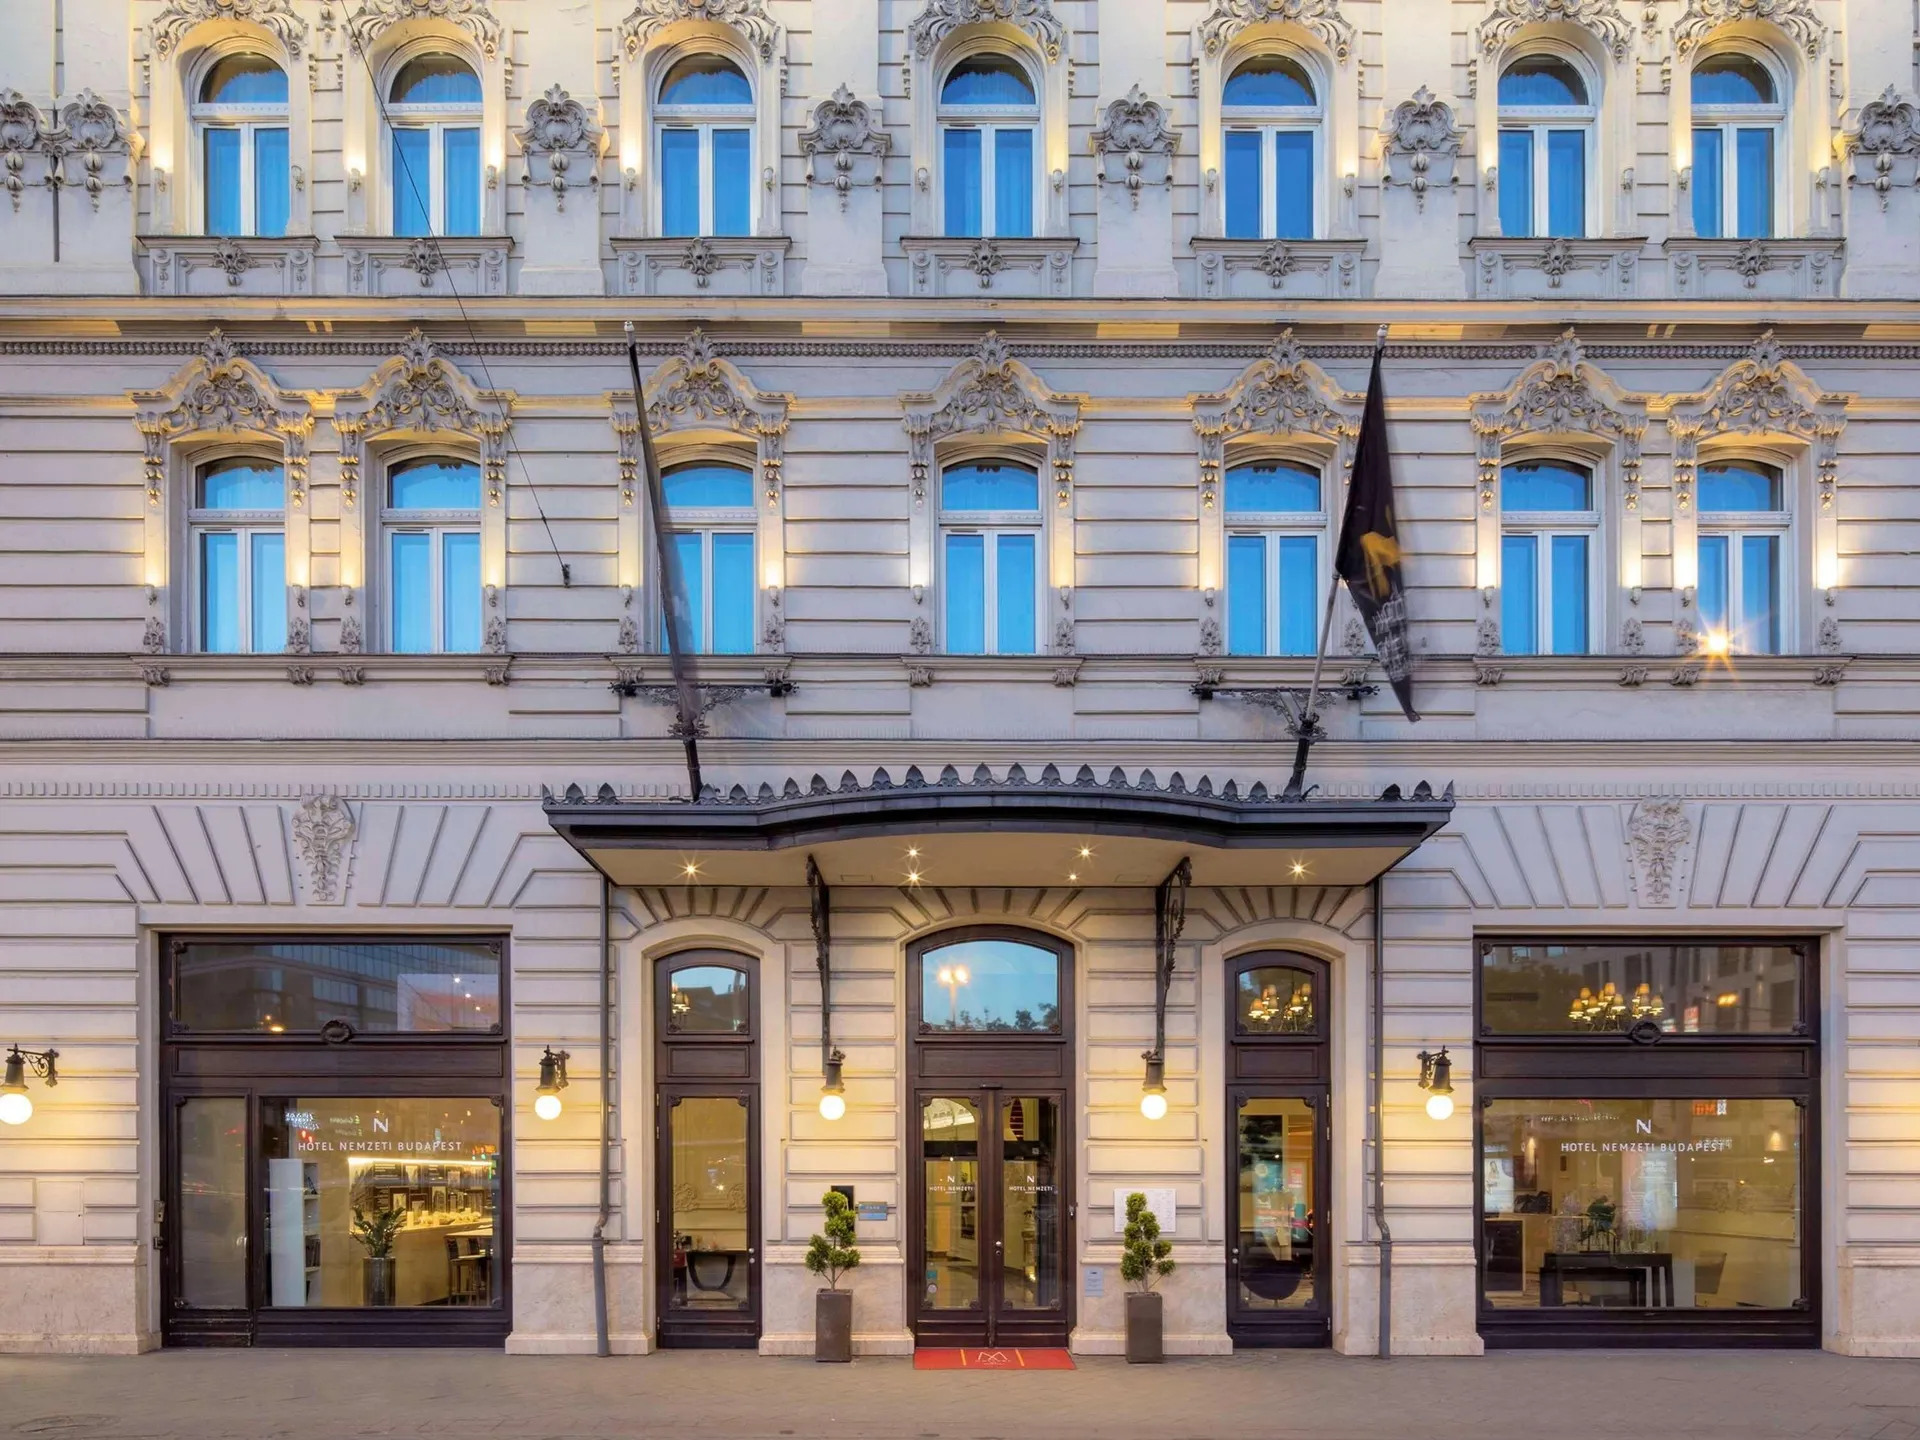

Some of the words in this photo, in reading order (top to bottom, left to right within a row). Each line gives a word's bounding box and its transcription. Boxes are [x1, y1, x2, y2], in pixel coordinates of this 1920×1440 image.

[373, 1117, 389, 1133] N
[1635, 1118, 1652, 1134] N
[298, 1141, 334, 1151] HOTEL
[339, 1141, 392, 1151] NEMZETI
[397, 1141, 462, 1151] BUDAPEST
[1561, 1142, 1597, 1152] HOTEL
[1602, 1142, 1655, 1152] NEMZETI
[1660, 1142, 1725, 1152] BUDAPEST
[947, 1175, 955, 1183] N
[1026, 1175, 1035, 1183] N
